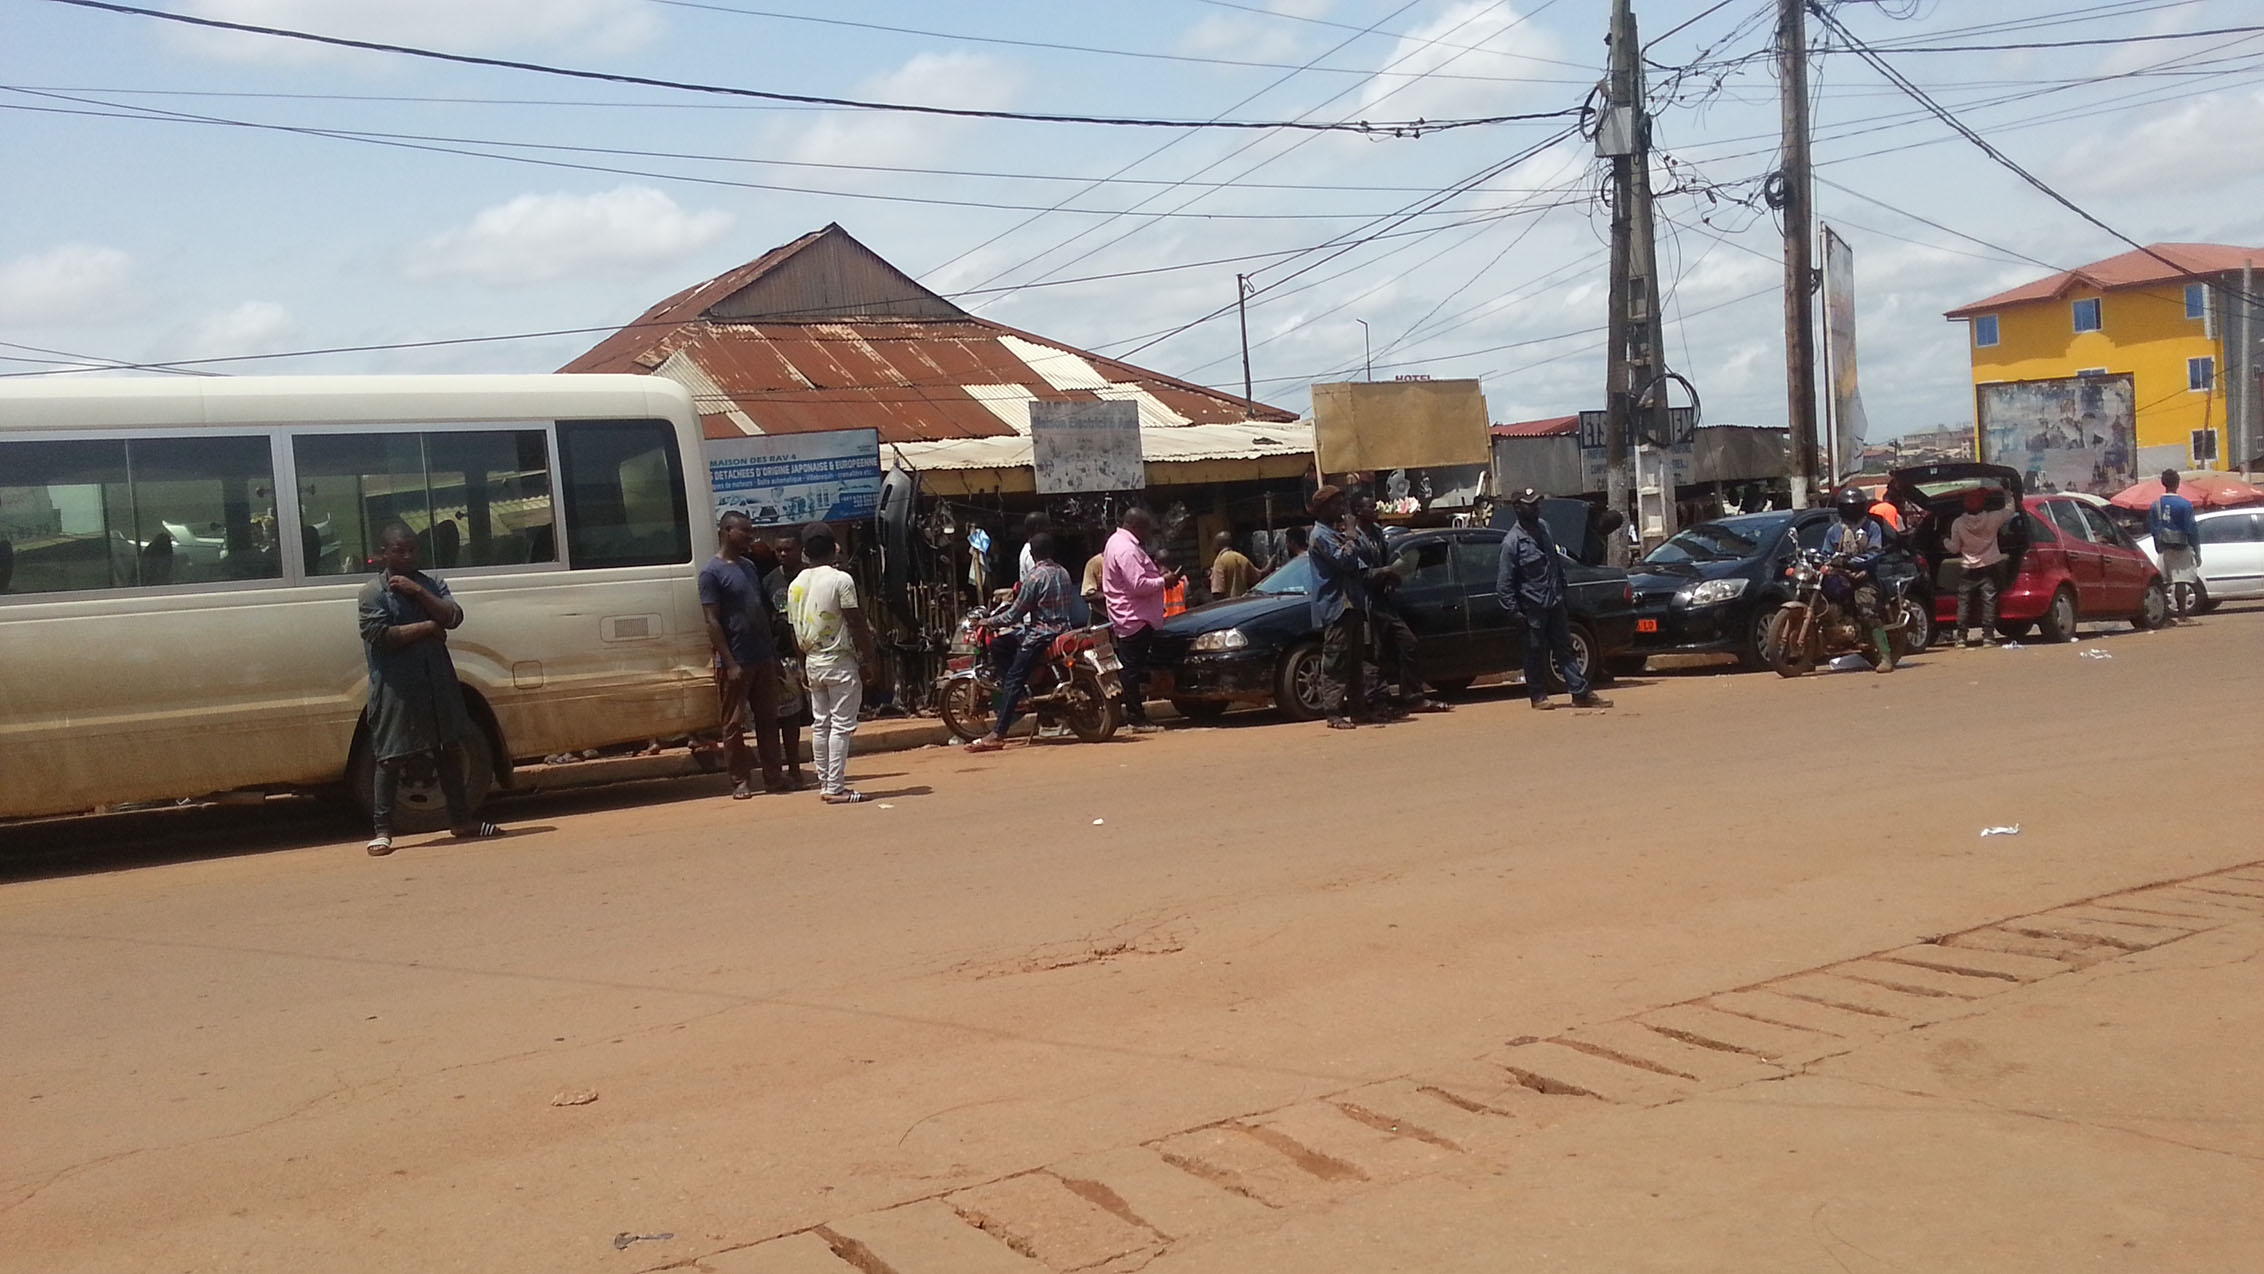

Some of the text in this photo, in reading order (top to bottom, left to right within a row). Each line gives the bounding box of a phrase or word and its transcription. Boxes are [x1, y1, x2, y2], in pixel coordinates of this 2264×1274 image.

[710, 458, 747, 467] MAISON
[750, 456, 767, 464] DES
[769, 454, 789, 462] RAV
[756, 465, 790, 477] D'ORIGINE
[791, 462, 828, 474] JAPONAISE
